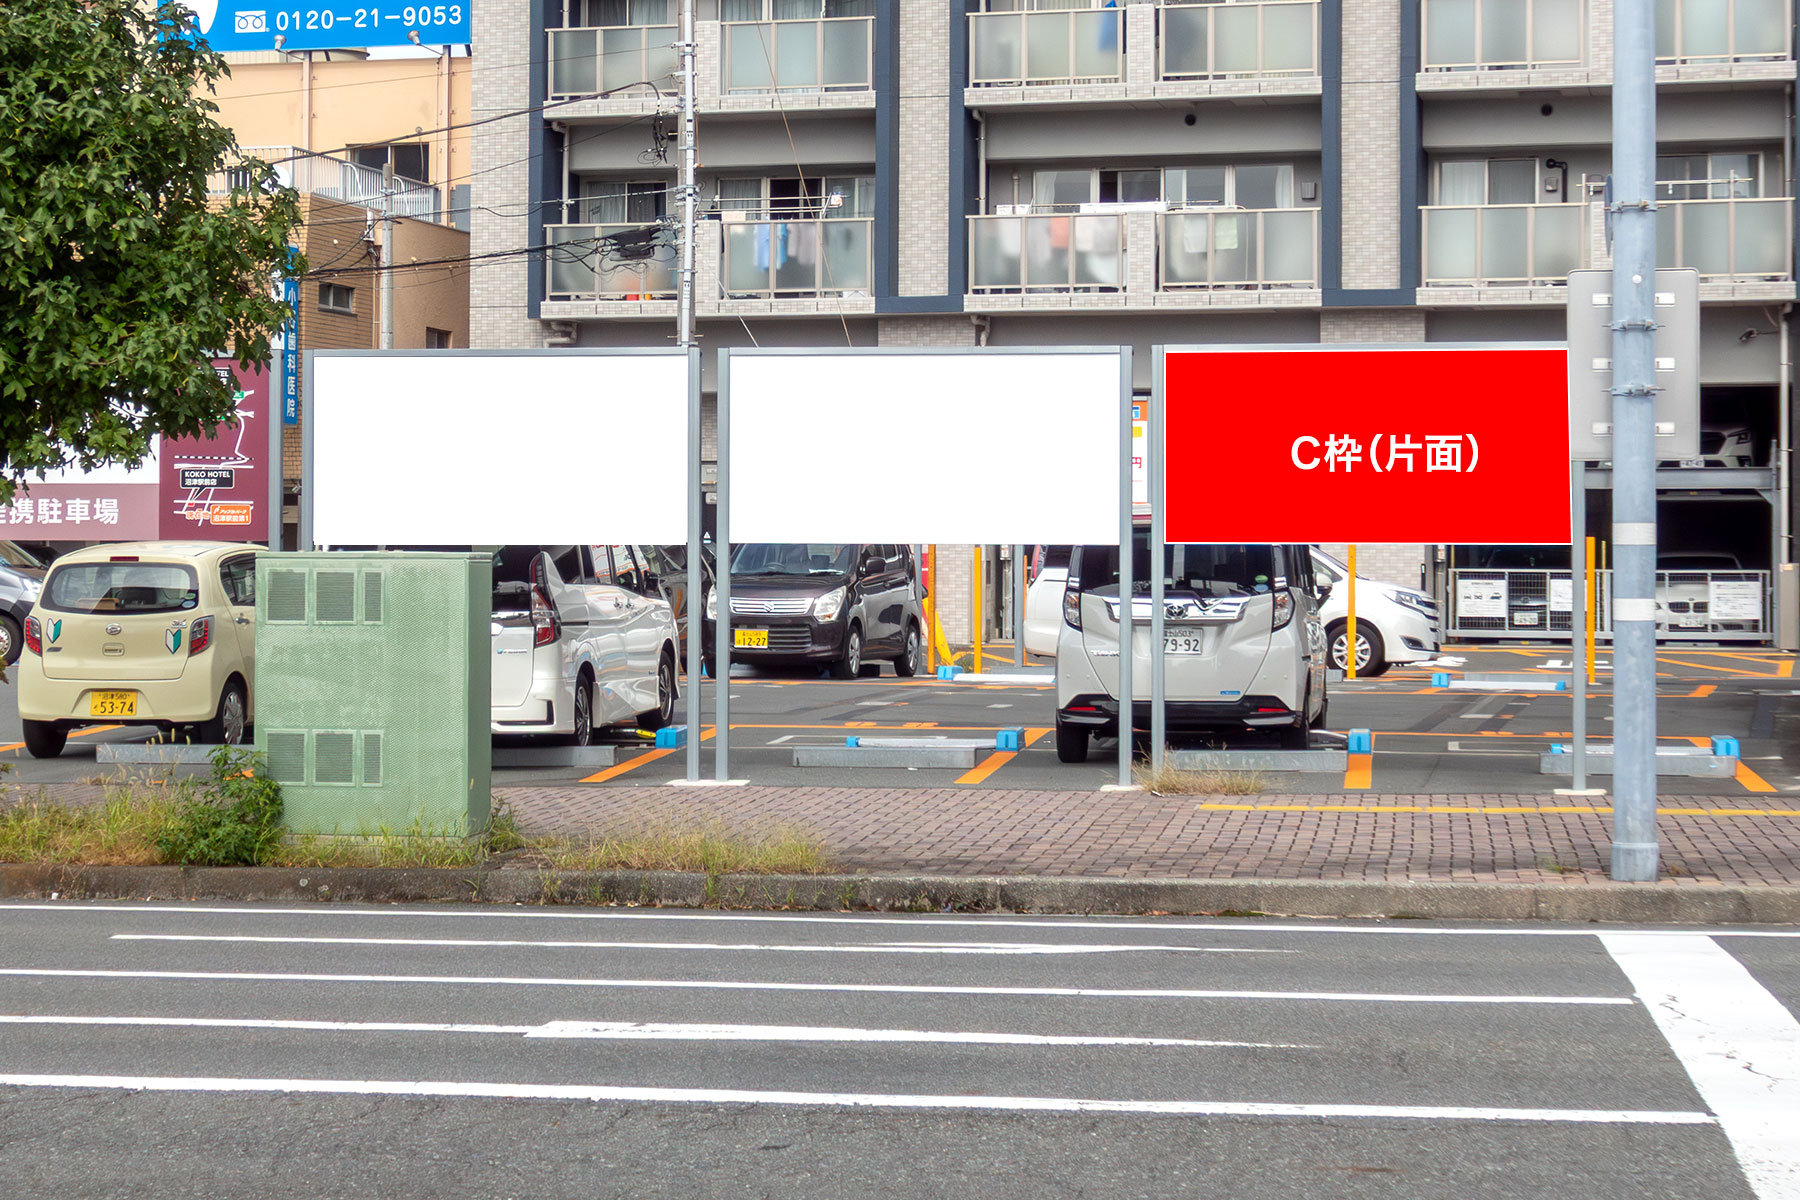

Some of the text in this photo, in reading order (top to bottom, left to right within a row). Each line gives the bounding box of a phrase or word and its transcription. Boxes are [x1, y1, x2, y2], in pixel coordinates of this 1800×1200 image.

[276, 5, 462, 31] 0120-21-9053
[287, 287, 296, 417] 小歯科医院
[0, 498, 119, 525] 携駐車場
[742, 638, 767, 646] 12-27
[99, 701, 134, 714] 53-74
